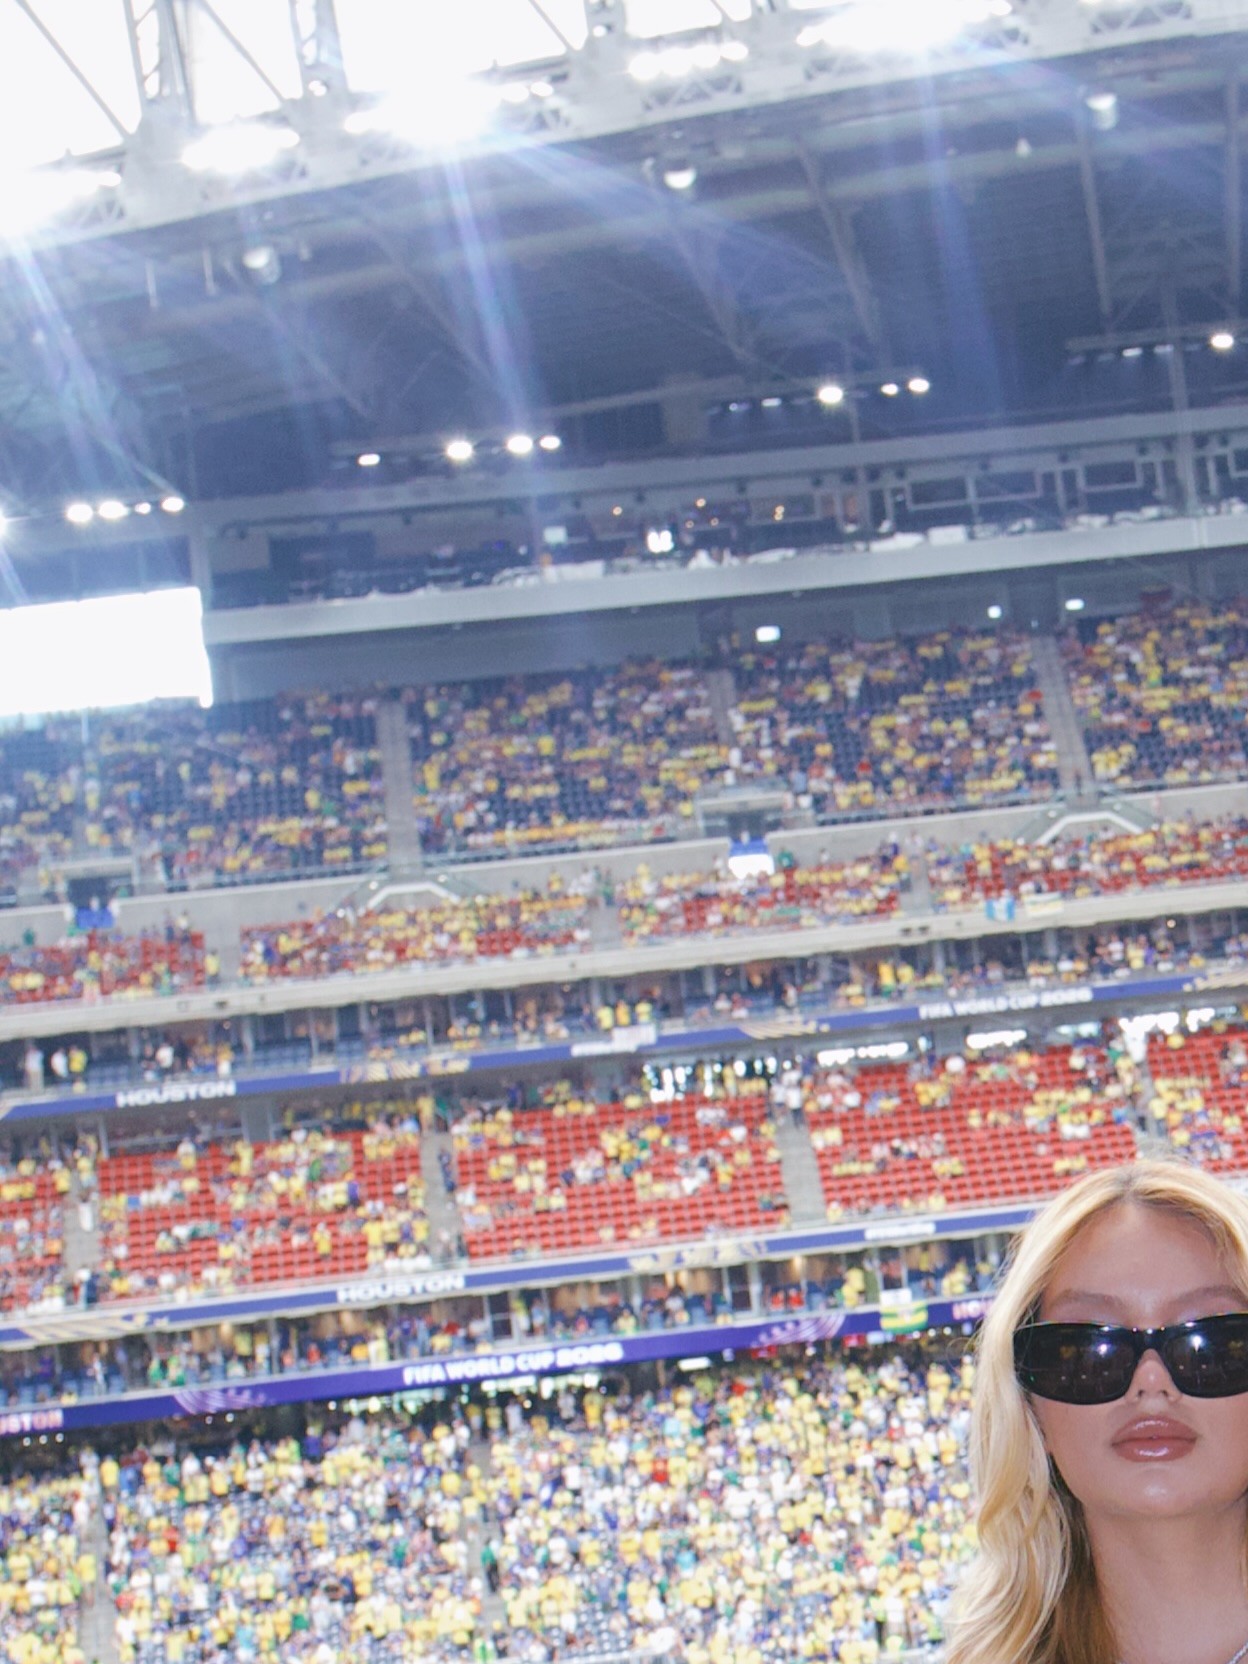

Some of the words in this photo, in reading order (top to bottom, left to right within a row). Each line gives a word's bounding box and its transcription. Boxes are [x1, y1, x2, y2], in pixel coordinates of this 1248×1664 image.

[955, 996, 1008, 1015] WORLD
[1009, 993, 1039, 1008] CUP
[116, 1081, 236, 1107] HOUSTON
[337, 1275, 465, 1303] HOUSTON
[403, 1365, 446, 1384] FIFA
[446, 1355, 514, 1380] WORLD
[516, 1350, 555, 1373] CUP
